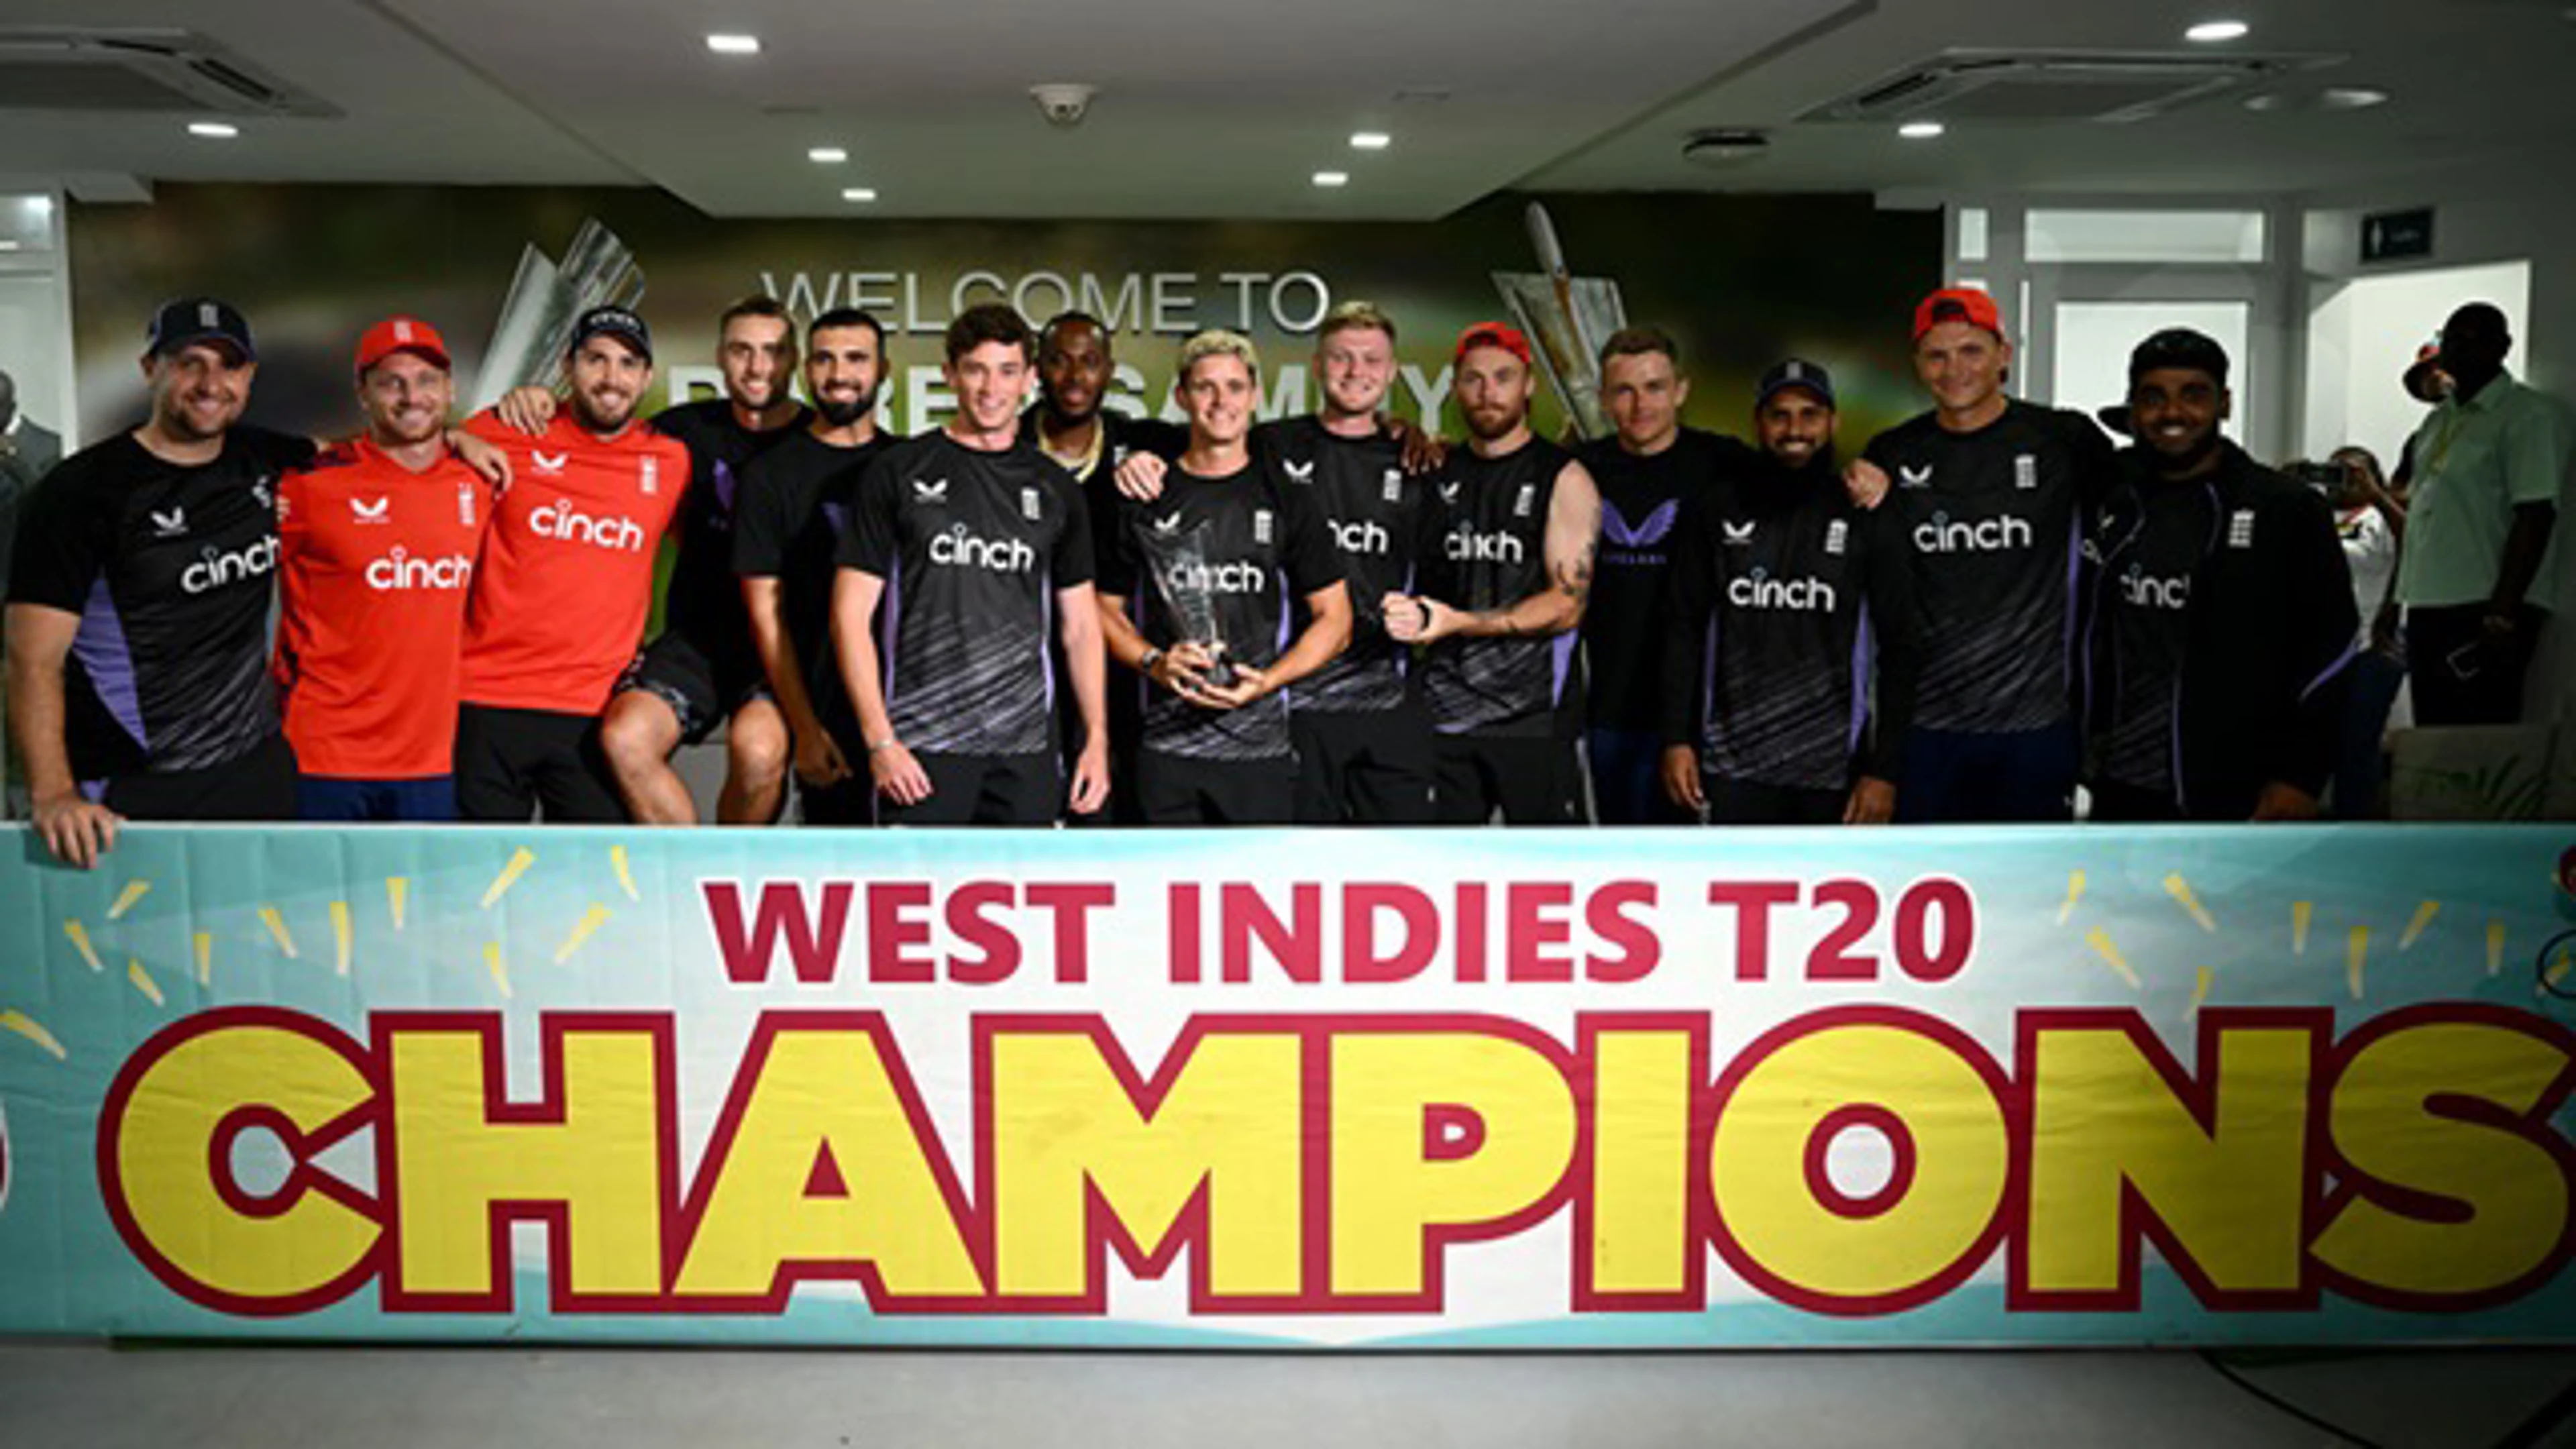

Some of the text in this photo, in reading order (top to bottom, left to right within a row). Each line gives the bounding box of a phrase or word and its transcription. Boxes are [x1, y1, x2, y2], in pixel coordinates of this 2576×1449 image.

[760, 270, 1330, 333] WELCOME TO
[529, 500, 644, 551] cinch
[930, 522, 1034, 571] cinch
[1913, 510, 2031, 553] cinch
[365, 543, 472, 590] cinch
[1727, 566, 1836, 612] cinch
[702, 877, 1975, 985] WEST INDIES T20
[96, 1004, 2576, 1318] CHAMPIONS
